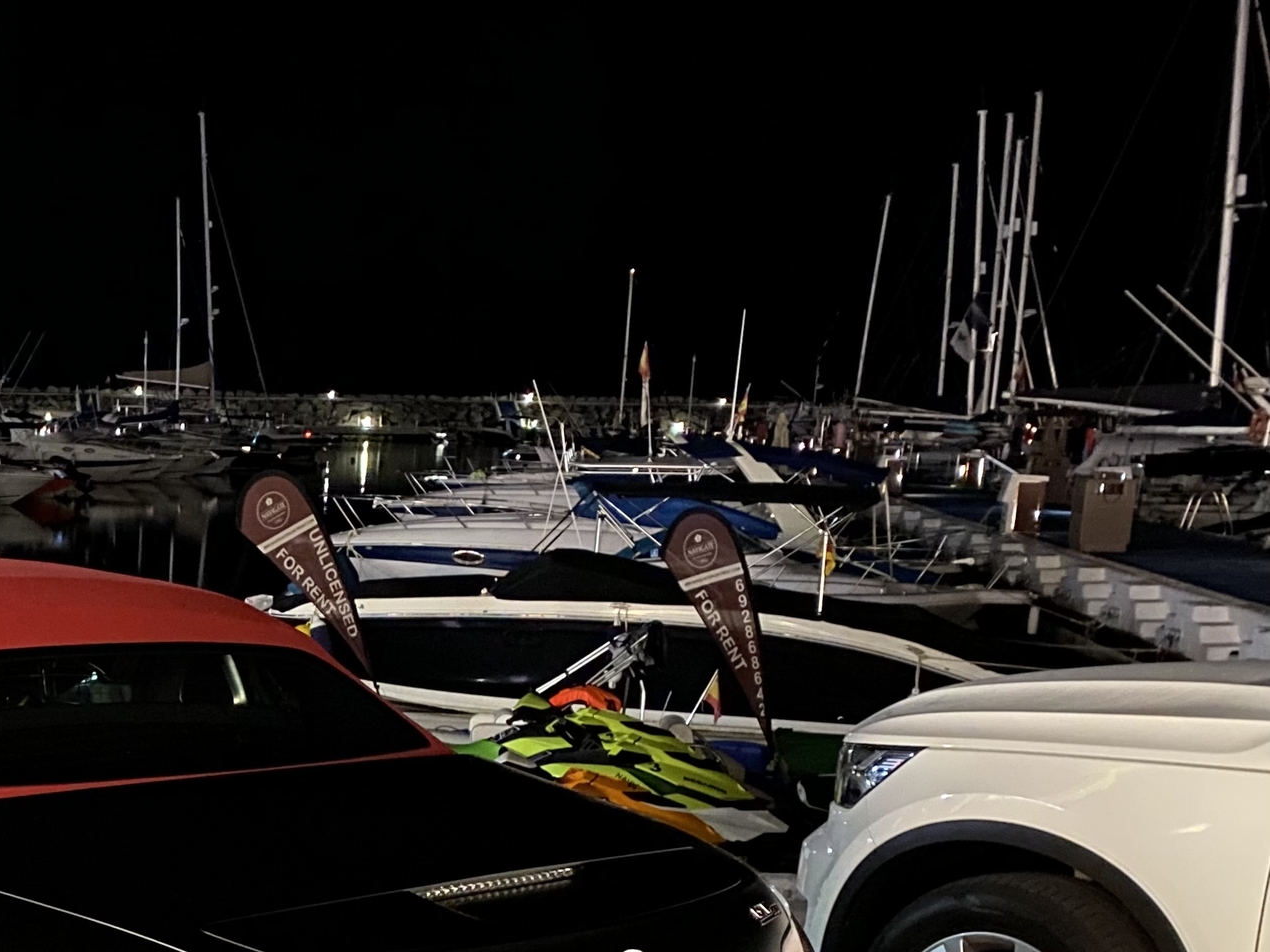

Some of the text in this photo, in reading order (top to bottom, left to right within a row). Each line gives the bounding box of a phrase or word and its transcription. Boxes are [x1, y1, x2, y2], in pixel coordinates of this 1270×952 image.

[275, 548, 305, 581] FOR
[302, 576, 337, 615] RENT
[309, 527, 358, 638] UNLICENSED
[695, 589, 721, 627] FOR
[716, 625, 748, 670] RENT
[735, 578, 766, 717] 692868642
